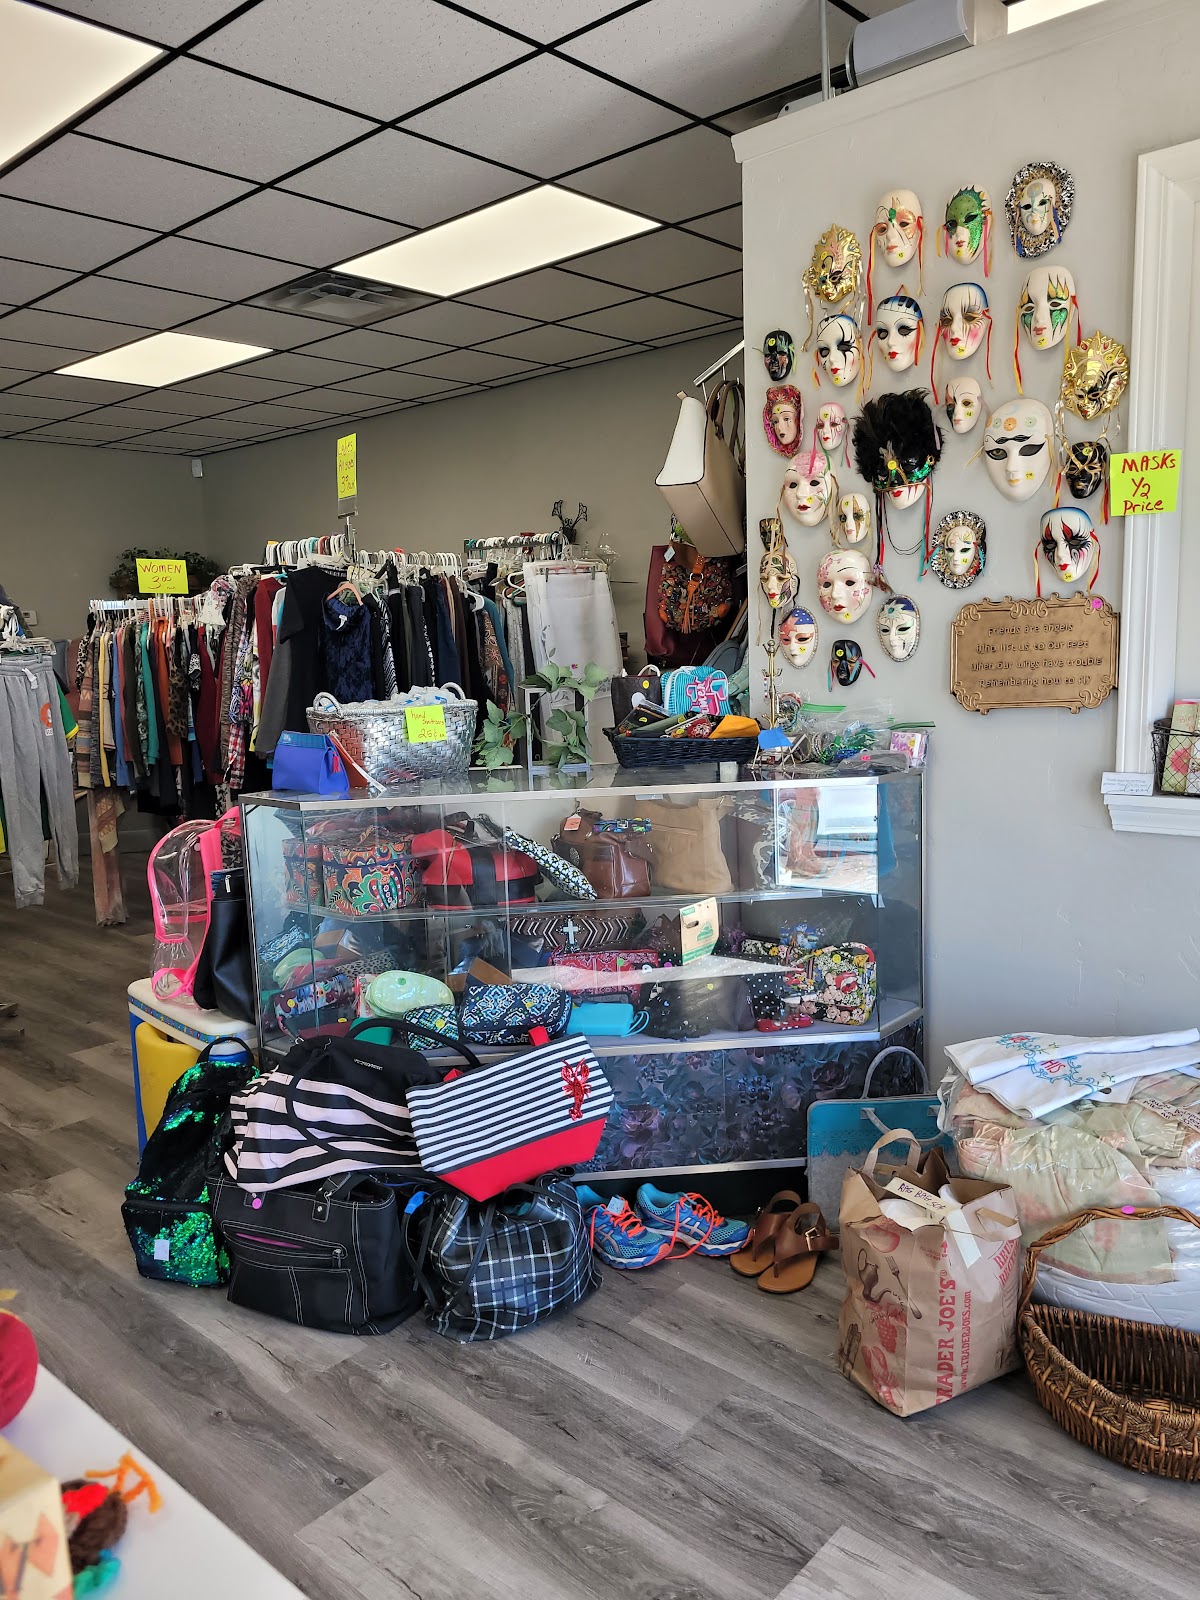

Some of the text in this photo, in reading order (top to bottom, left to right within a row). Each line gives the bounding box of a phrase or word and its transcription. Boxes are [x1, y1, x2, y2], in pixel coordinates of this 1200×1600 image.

[138, 562, 181, 574] WOMEN
[1024, 625, 1040, 634] are
[1043, 623, 1074, 634] angels
[1000, 642, 1016, 652] lift
[1018, 642, 1030, 652] us
[1033, 642, 1046, 651] to
[1016, 660, 1040, 670] wings
[1043, 659, 1064, 668] have
[1067, 657, 1103, 667] trouble
[979, 677, 1039, 688] Remembering
[1042, 677, 1060, 685] how
[1065, 677, 1075, 685] to
[935, 1338, 954, 1405] RADER
